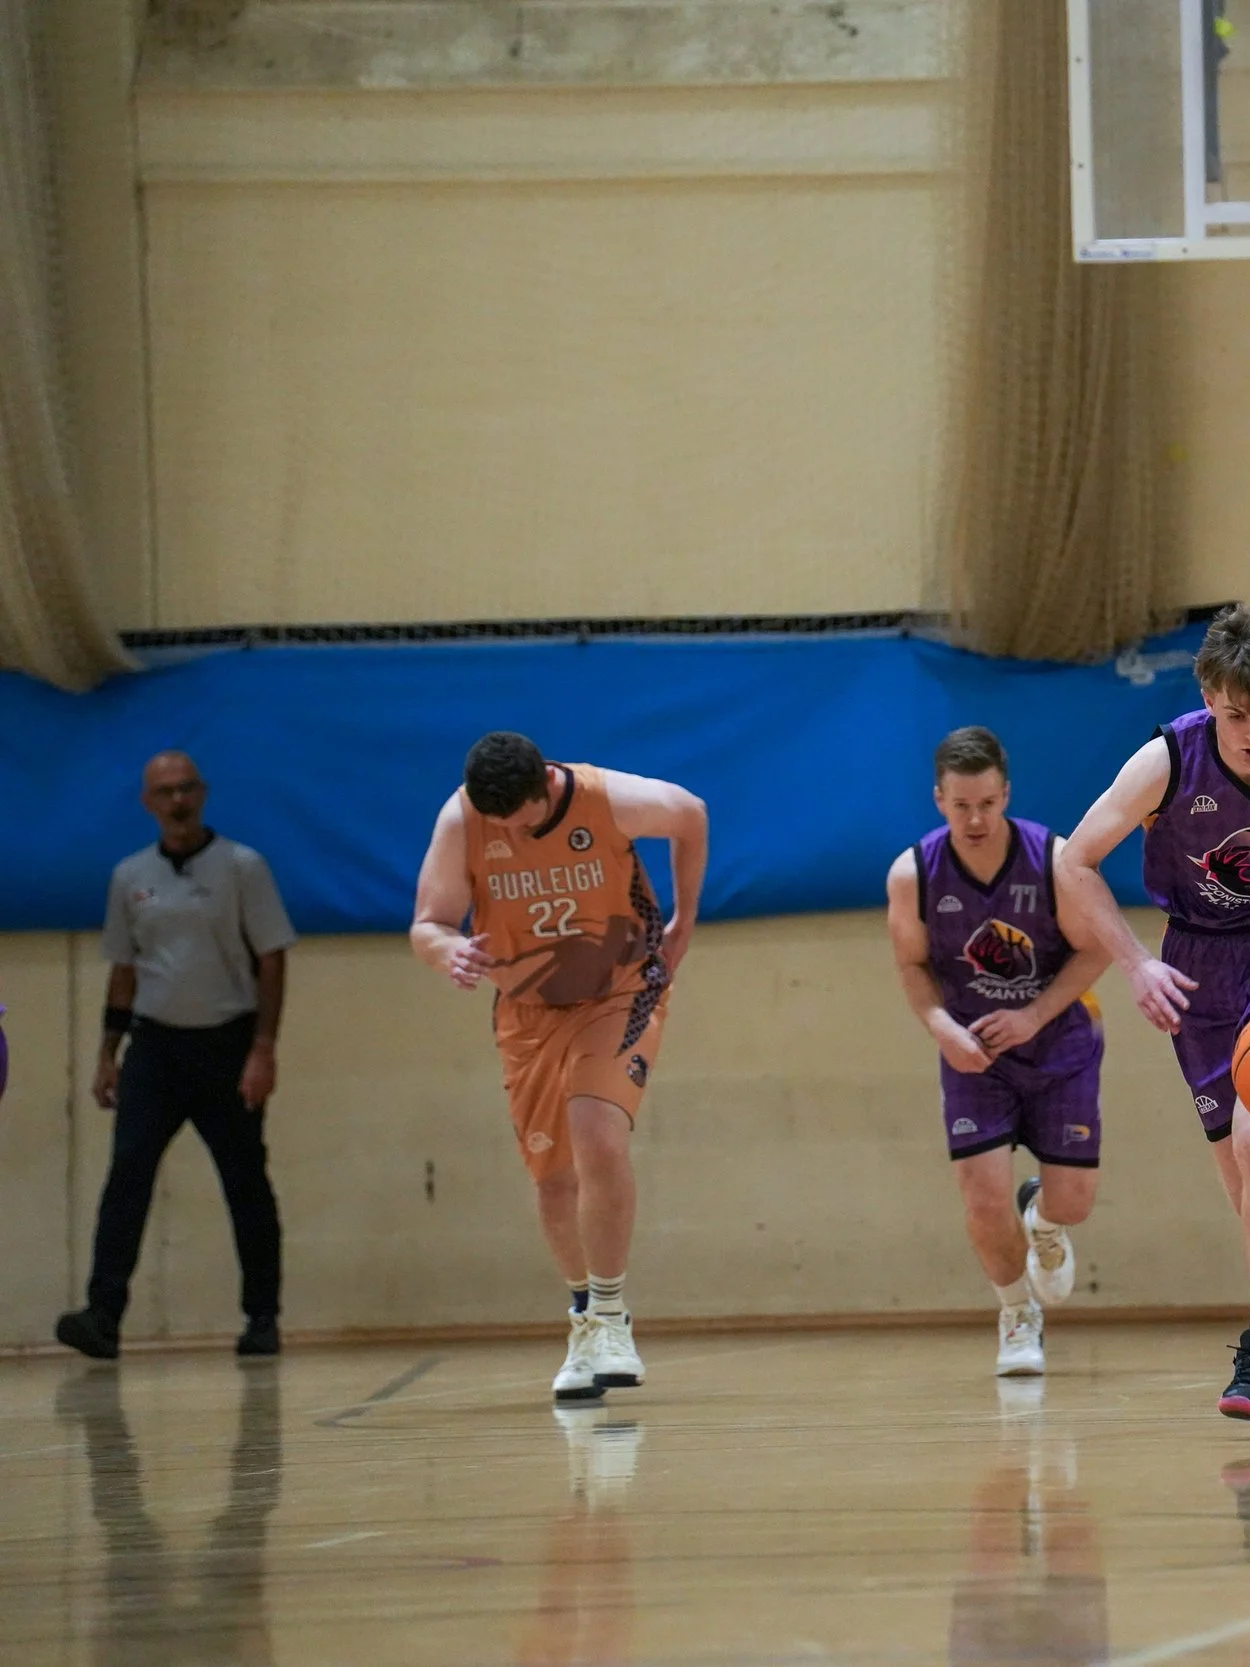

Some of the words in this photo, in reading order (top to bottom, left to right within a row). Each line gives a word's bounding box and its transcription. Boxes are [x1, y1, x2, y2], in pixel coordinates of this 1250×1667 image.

[488, 859, 605, 900] BURLEIGH
[1009, 884, 1037, 913] 77
[528, 897, 583, 938] 22
